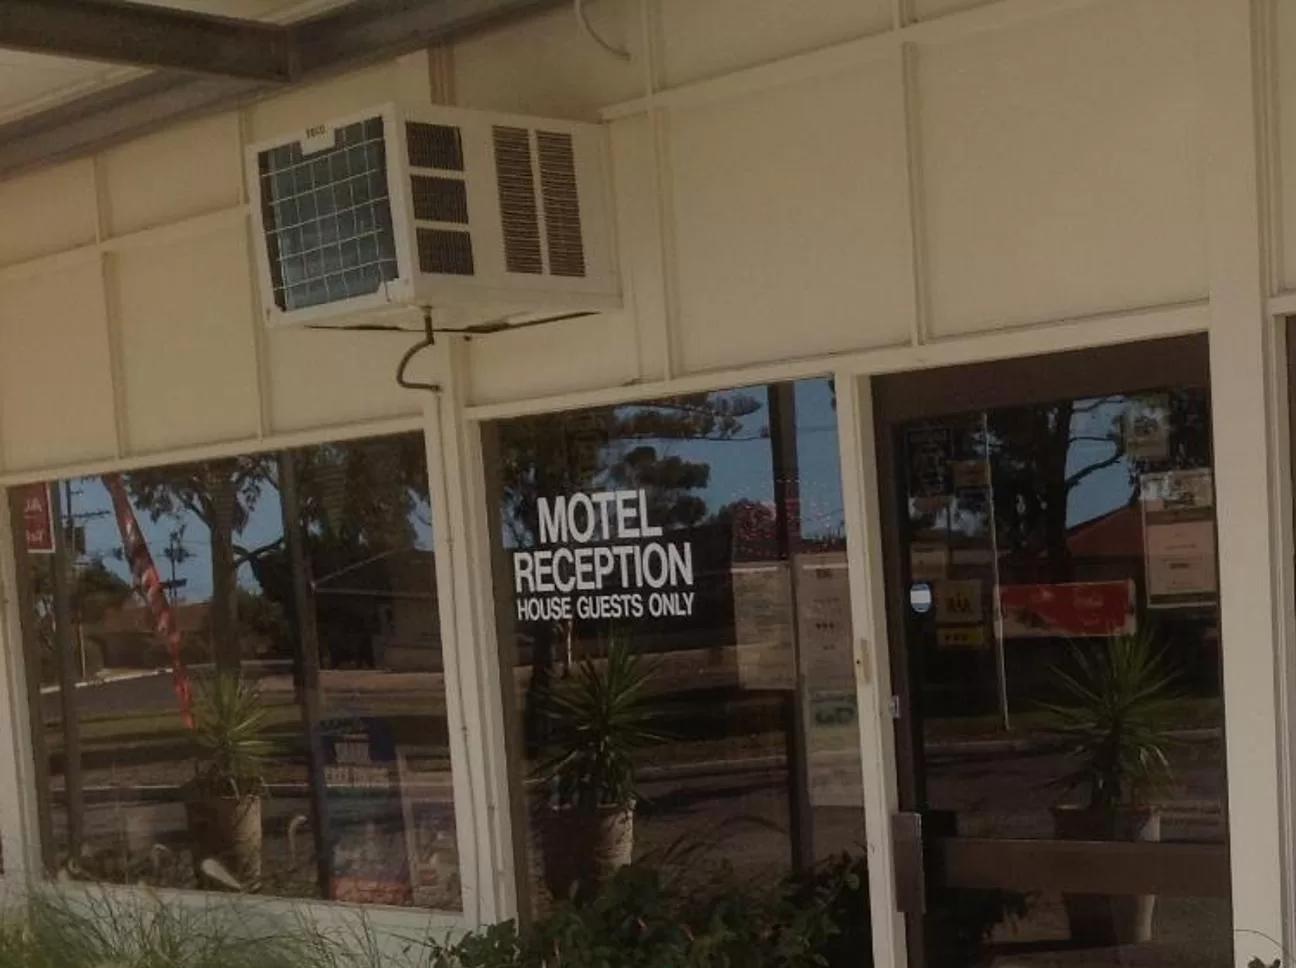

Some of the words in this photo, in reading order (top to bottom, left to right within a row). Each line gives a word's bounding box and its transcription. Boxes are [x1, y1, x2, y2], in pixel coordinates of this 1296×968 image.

[537, 489, 663, 543] MOTEL
[513, 541, 694, 593] RECEPTION
[517, 596, 573, 621] HOUSE
[576, 593, 644, 619] GUESTS
[649, 592, 695, 618] ONLY
